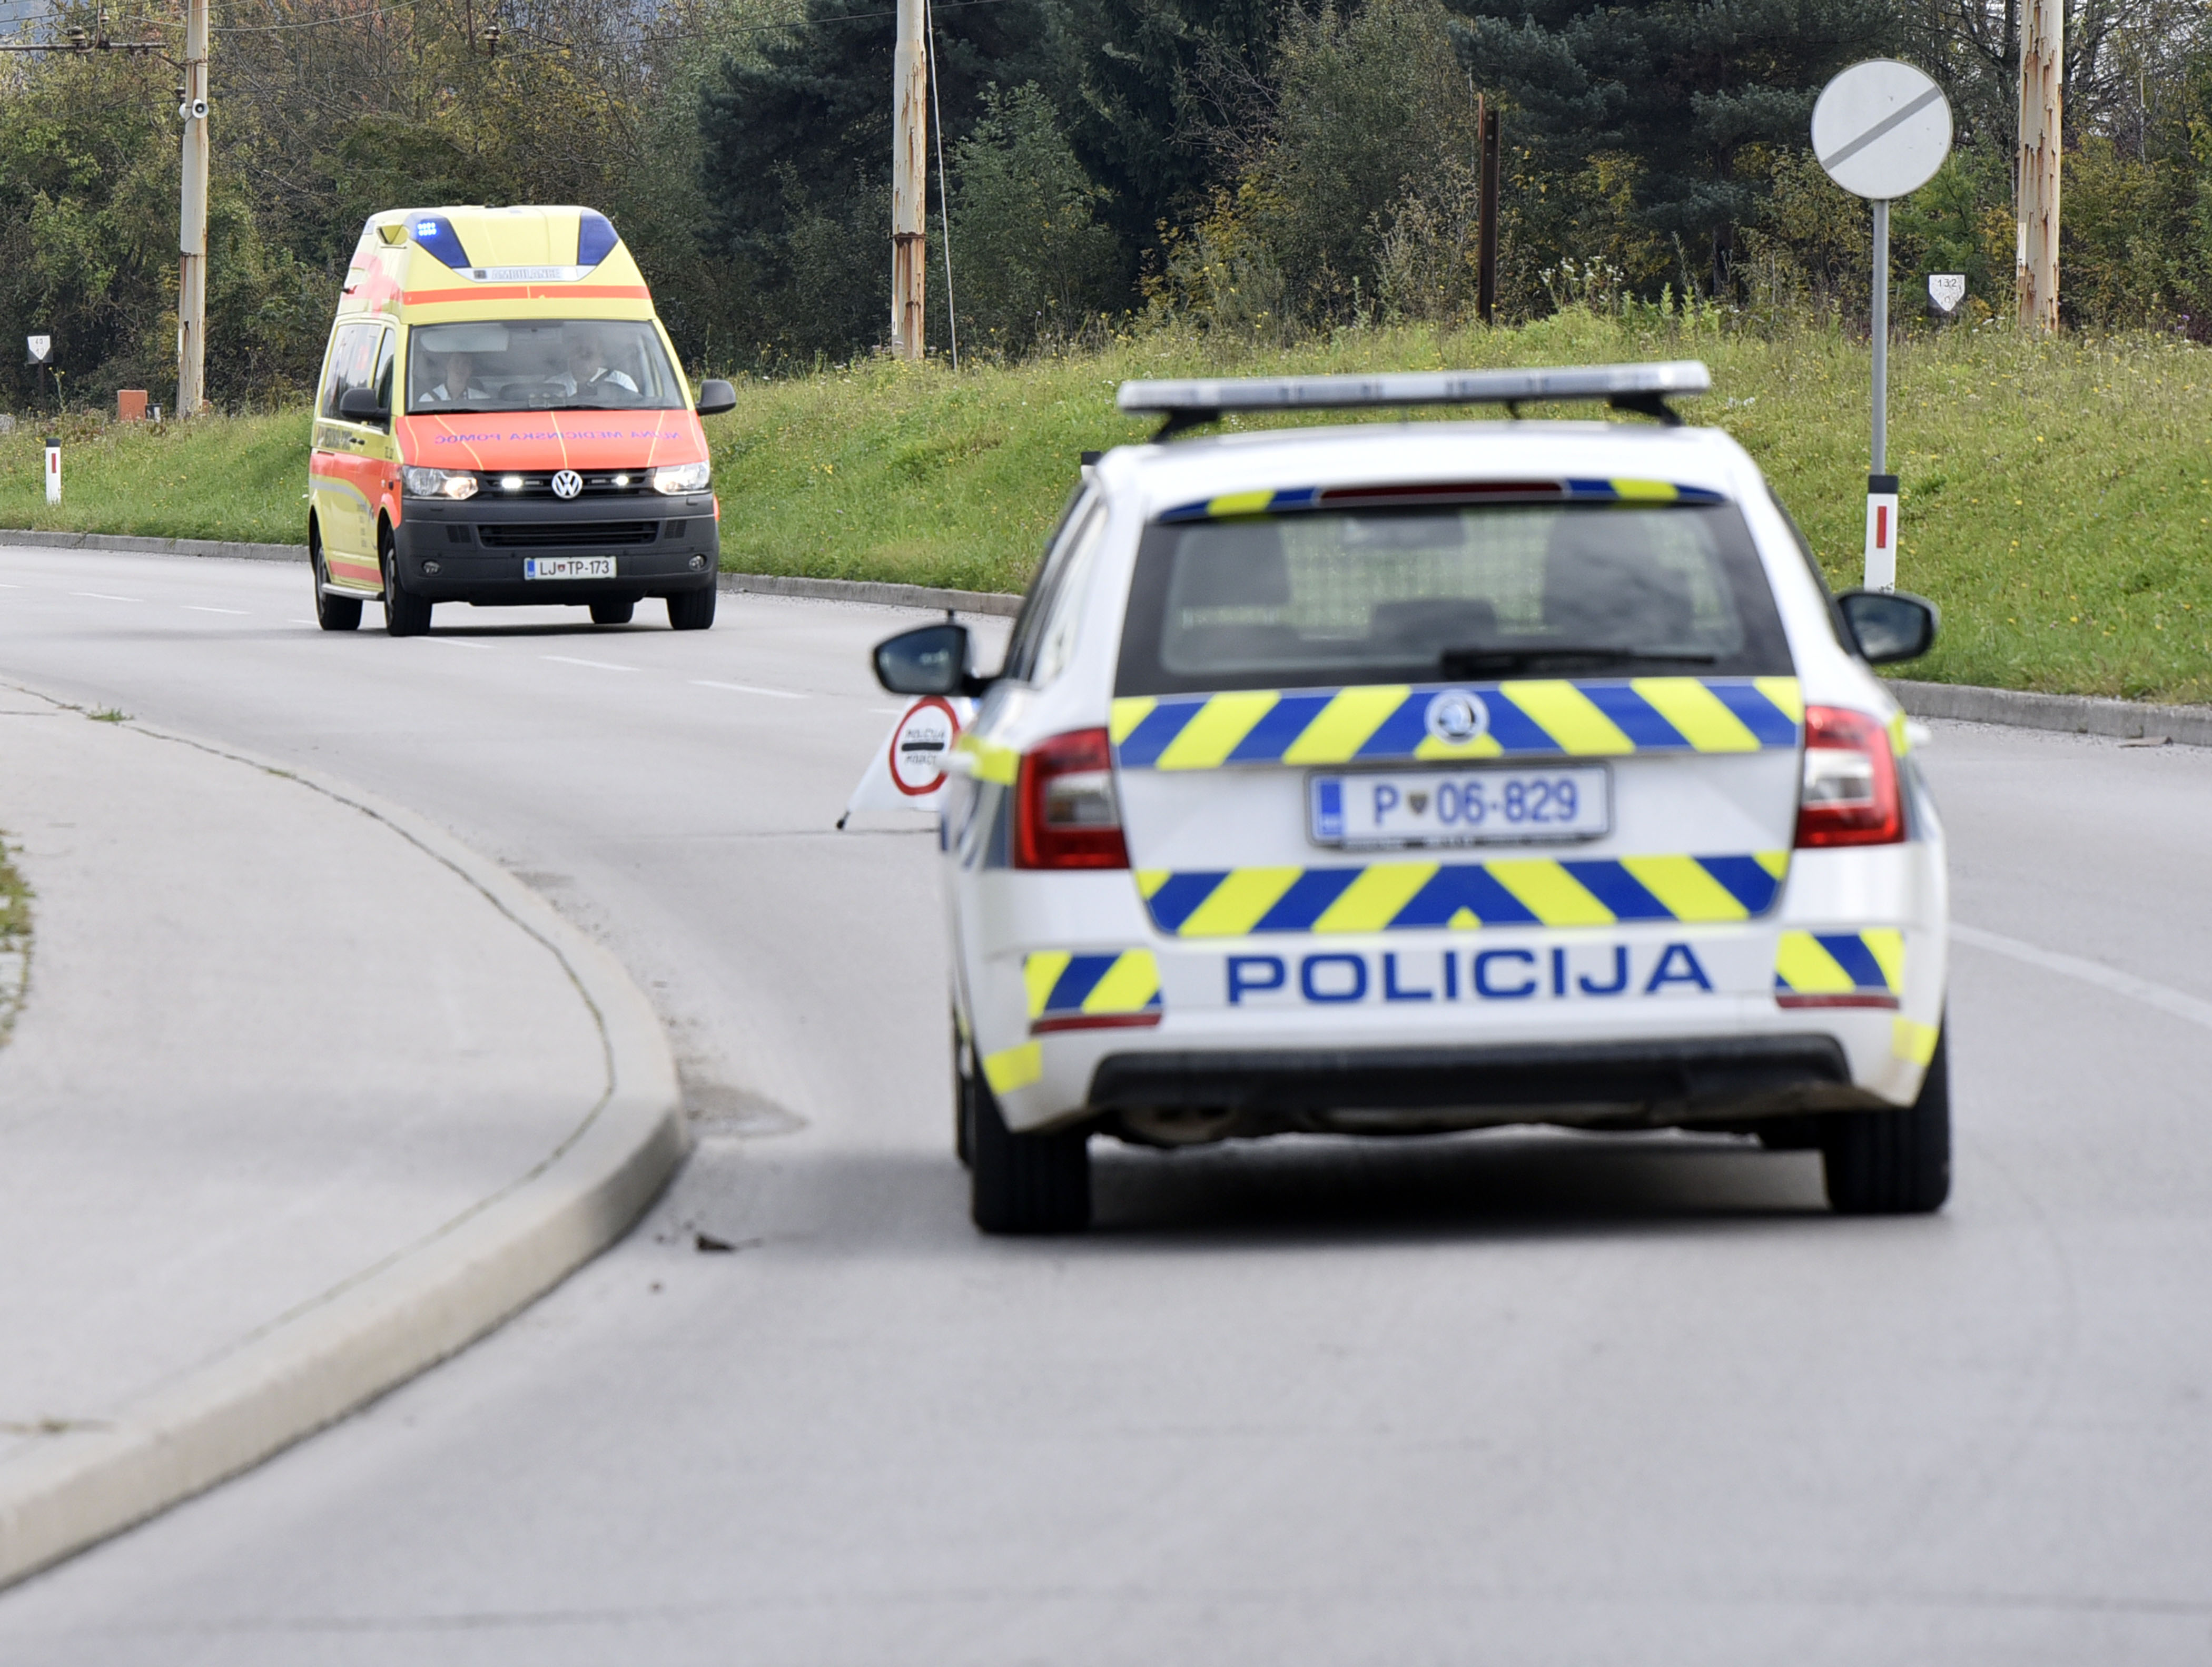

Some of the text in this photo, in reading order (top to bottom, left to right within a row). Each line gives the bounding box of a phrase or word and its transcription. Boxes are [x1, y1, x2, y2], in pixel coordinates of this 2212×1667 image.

[1938, 279, 1957, 287] 132
[540, 560, 610, 576] LJ TP-173
[1374, 778, 1577, 825] P 06-829
[1226, 943, 1714, 1007] POLICIJA
